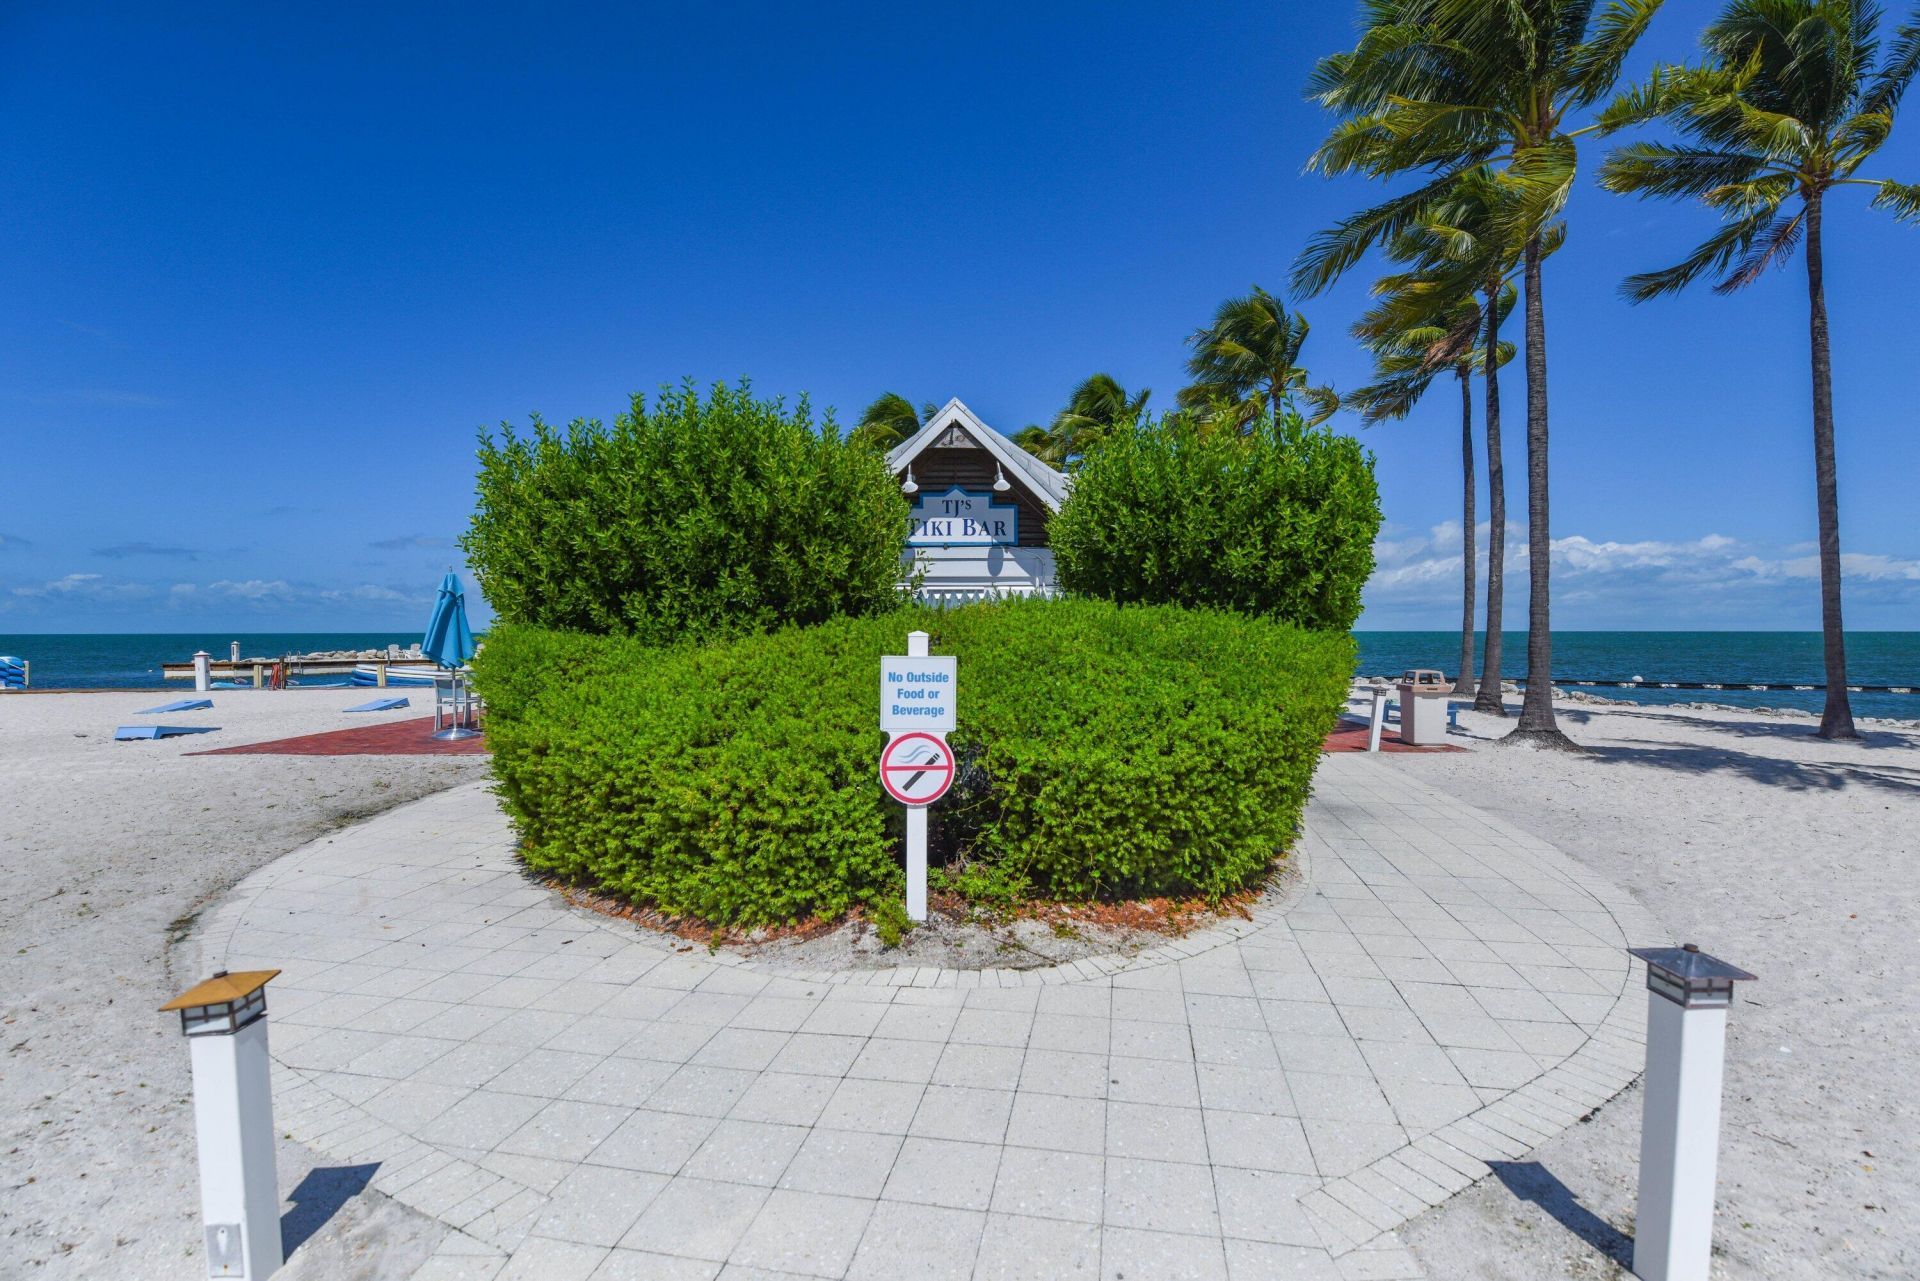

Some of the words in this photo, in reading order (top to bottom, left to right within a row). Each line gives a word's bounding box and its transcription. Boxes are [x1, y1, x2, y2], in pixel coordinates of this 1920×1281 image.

[963, 518, 1006, 536] BAR
[888, 672, 903, 682] No
[907, 672, 949, 682] Outside
[897, 688, 924, 699] Food
[928, 690, 940, 699] or
[892, 705, 944, 718] Beverage
